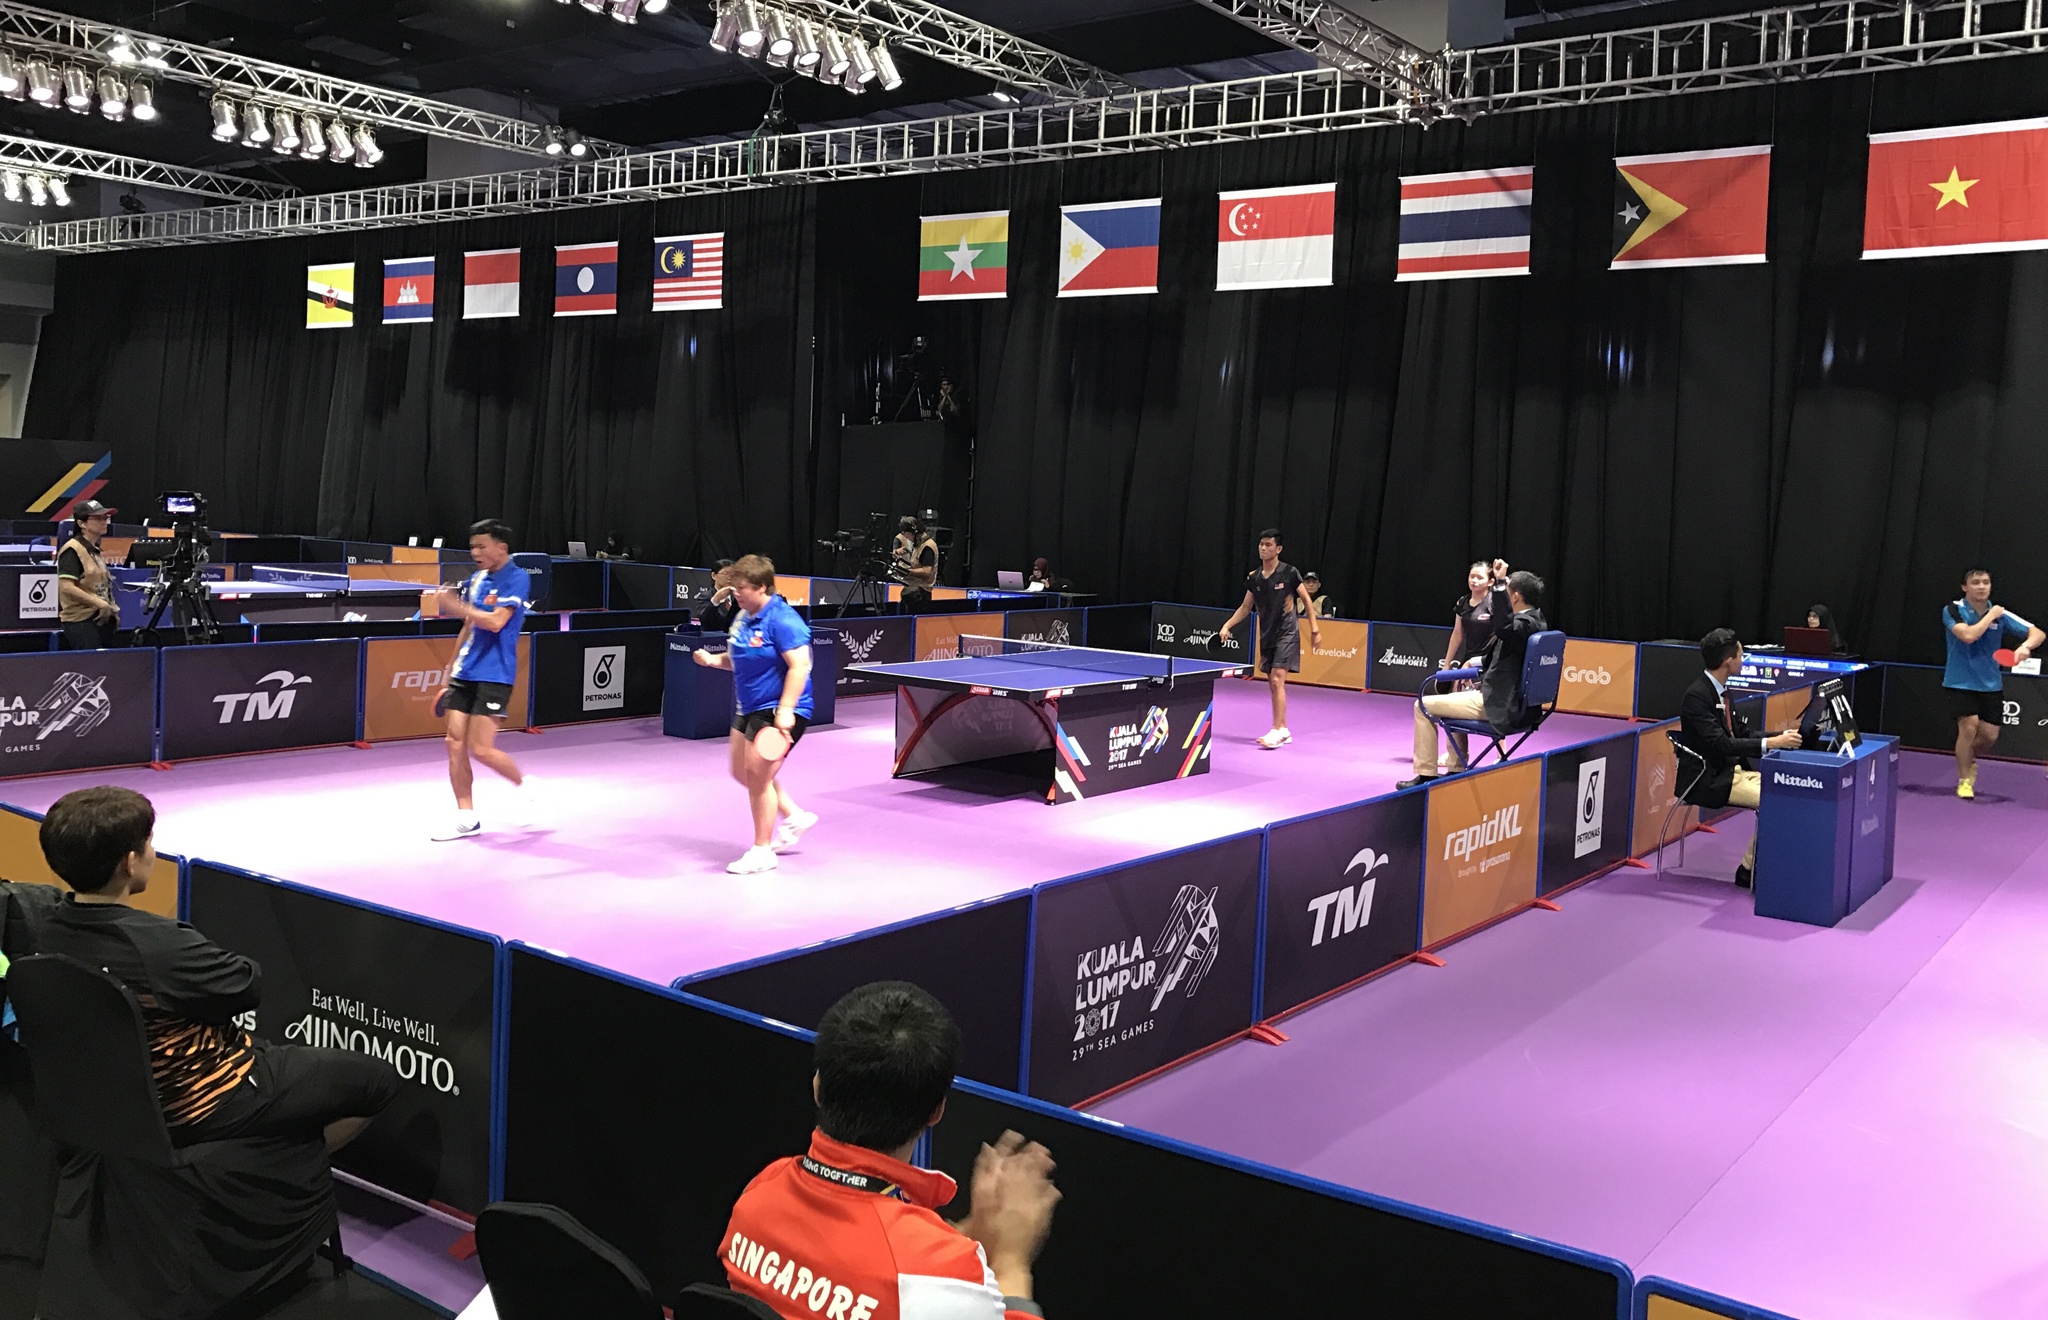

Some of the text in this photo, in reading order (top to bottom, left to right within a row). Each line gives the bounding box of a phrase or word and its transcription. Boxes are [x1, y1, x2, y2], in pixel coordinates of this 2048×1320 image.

[676, 584, 689, 594] 100
[1156, 634, 1175, 643] PLUS
[1157, 623, 1176, 636] 100
[1312, 646, 1352, 659] traveloka
[1391, 659, 1428, 668] AIRPORTS
[391, 664, 451, 692] rapi
[1563, 665, 1612, 686] Grab
[585, 692, 622, 702] PETRONAS
[213, 689, 297, 724] TM
[2001, 701, 2021, 717] 00
[0, 710, 40, 727] PUR
[2002, 716, 2020, 726] US
[1109, 723, 1138, 739] KUALA
[5, 744, 41, 753] GAMES
[1109, 735, 1143, 751] LUMPUR
[1108, 749, 1128, 763] 2017
[1773, 771, 1824, 790] Nittaku
[1443, 803, 1523, 863] rapidKL
[1576, 826, 1601, 845] PETRONAS
[1307, 877, 1377, 947] TM
[1077, 936, 1145, 981] KUALA
[1075, 960, 1156, 1011] LUMPUR
[312, 988, 440, 1047] Eat Well, Live Well.
[1073, 1000, 1121, 1042] 2017
[1098, 1034, 1117, 1051] SEA
[1121, 1018, 1155, 1041] GAMES
[728, 1231, 879, 1320] SINGAPORE
